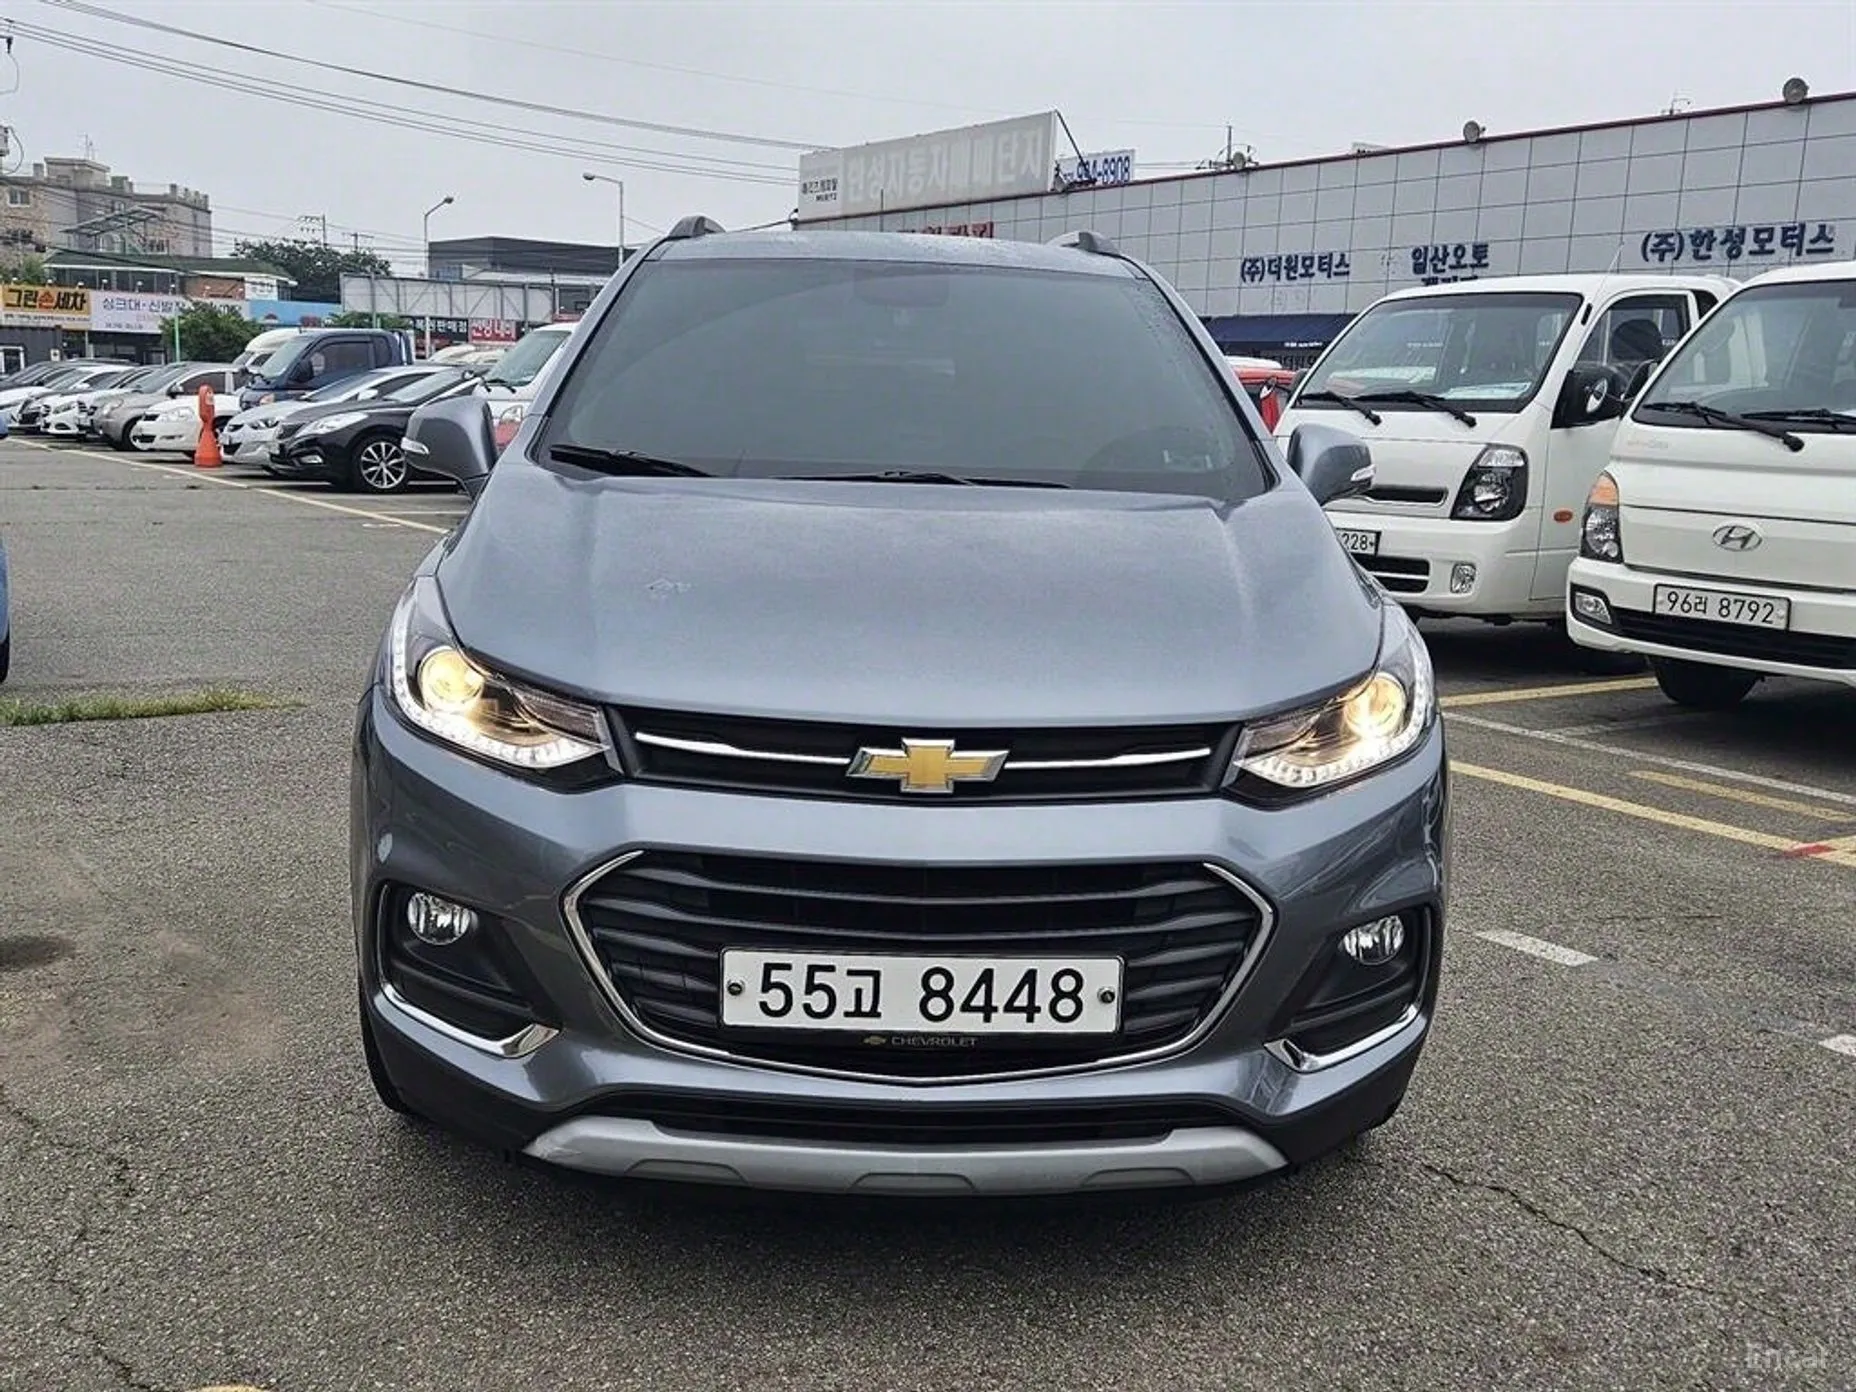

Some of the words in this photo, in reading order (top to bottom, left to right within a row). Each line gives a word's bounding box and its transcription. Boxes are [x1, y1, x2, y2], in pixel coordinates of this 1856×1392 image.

[1641, 222, 1834, 262] (주)한성모터스
[1240, 252, 1350, 283] (주)더원모터스
[5, 287, 87, 311] 그린손세차
[1336, 532, 1368, 551] 228
[1719, 596, 1775, 624] 8792
[757, 961, 883, 1020] 55고
[918, 965, 1085, 1024] 8448
[891, 1036, 978, 1047] CHEVROLET
